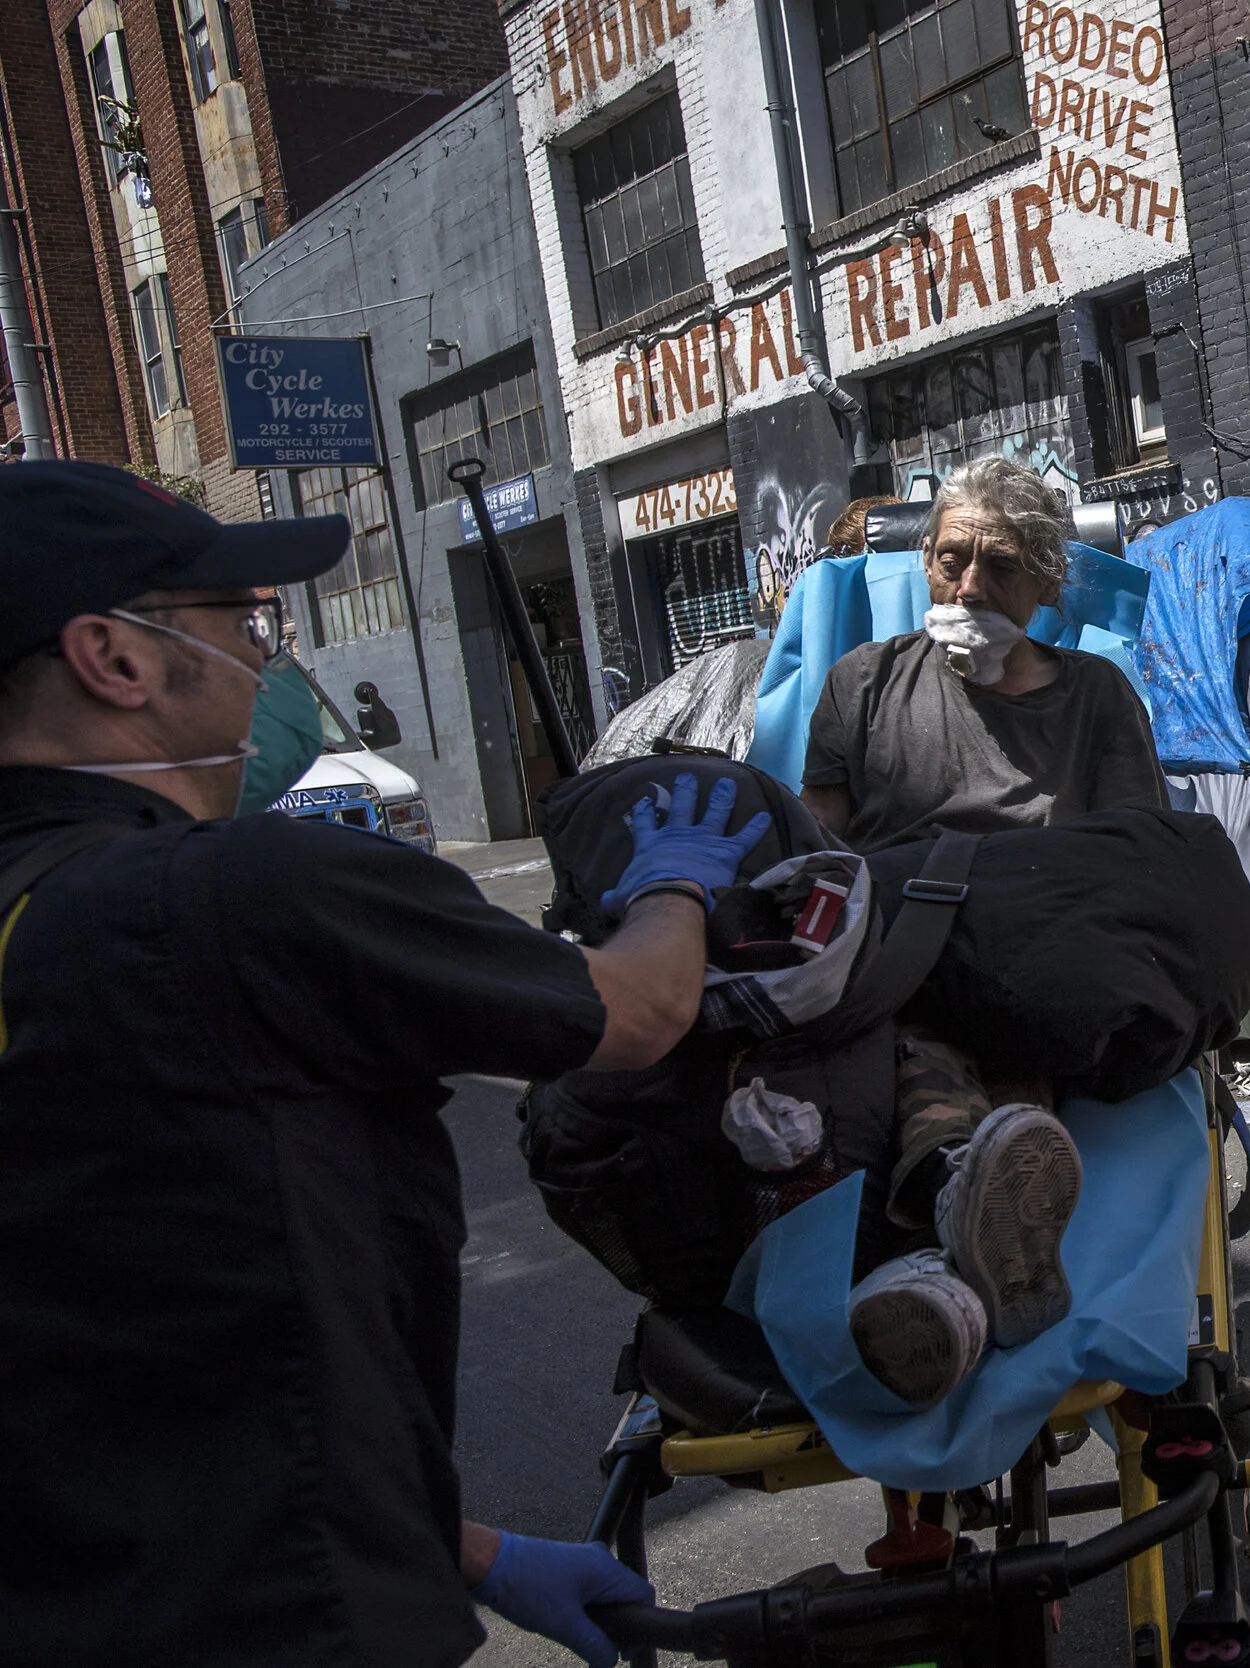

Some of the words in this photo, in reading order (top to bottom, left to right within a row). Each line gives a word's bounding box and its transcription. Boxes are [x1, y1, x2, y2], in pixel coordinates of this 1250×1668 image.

[1023, 0, 1163, 86] RODEO
[1031, 72, 1154, 160] DRIVE
[1048, 145, 1178, 243] NORTH
[613, 289, 804, 438] GENERAL
[846, 183, 1061, 353] REPAIR
[225, 342, 284, 369] City
[245, 368, 323, 395] Cycle
[270, 397, 364, 419] Werkes
[237, 438, 313, 447] MOTORCYCLE
[322, 437, 373, 447] SCOOTER
[259, 424, 290, 435] 292
[309, 424, 348, 435] 3577
[275, 449, 341, 460] SERVICE
[499, 482, 529, 506] WERKES
[636, 468, 738, 532] 474-7323
